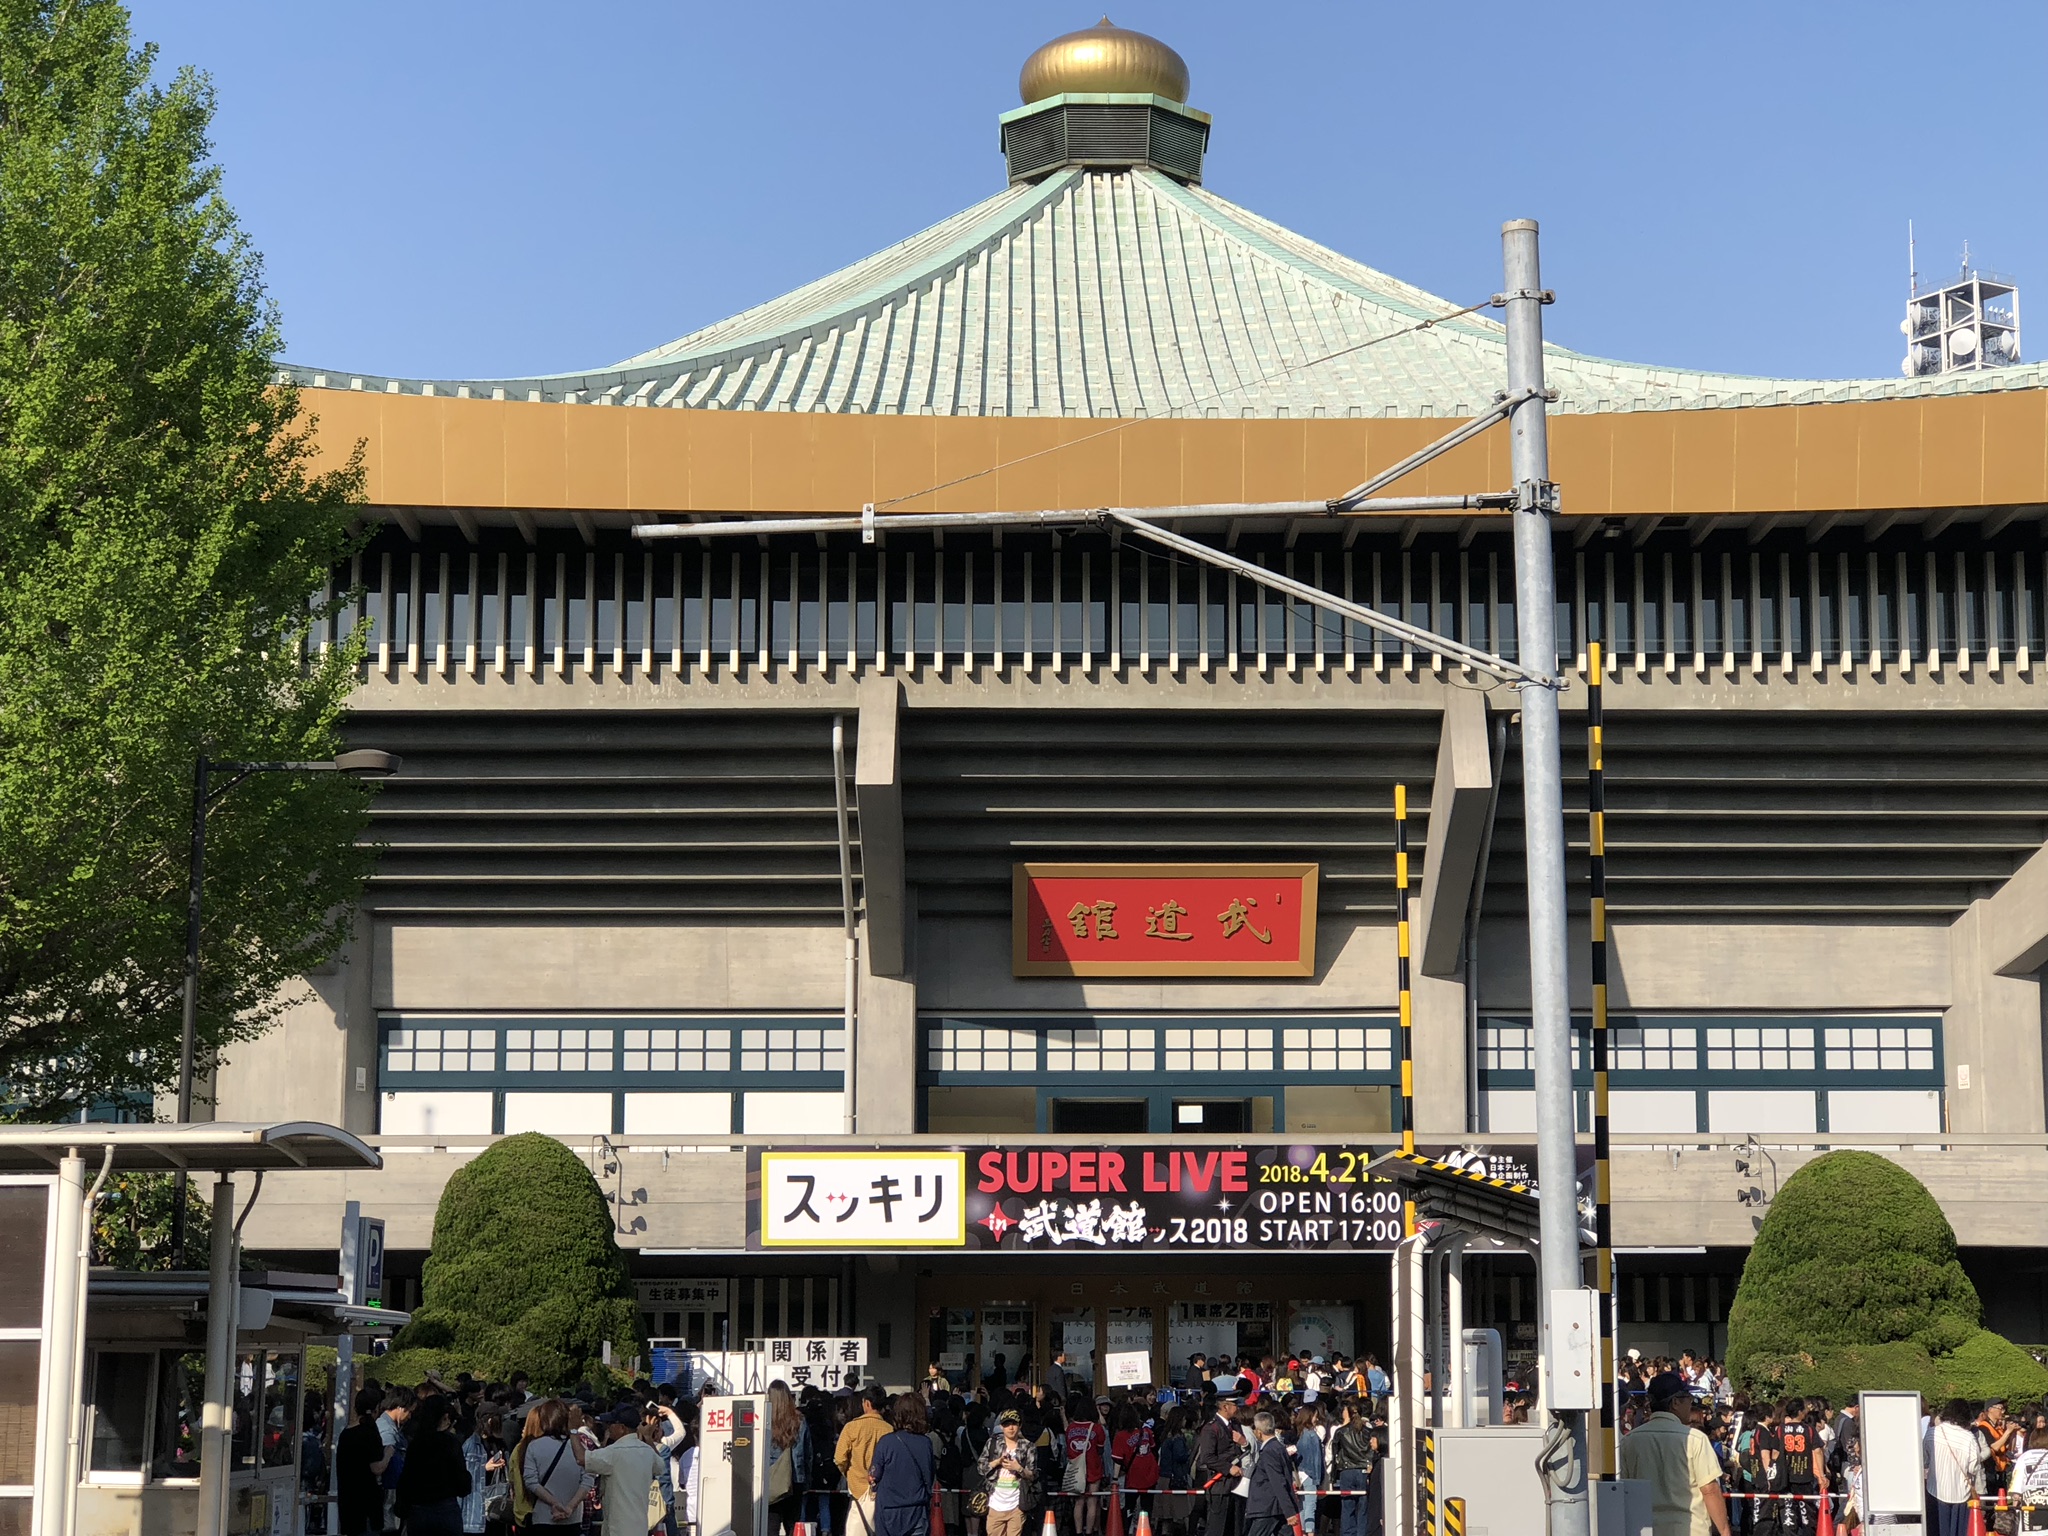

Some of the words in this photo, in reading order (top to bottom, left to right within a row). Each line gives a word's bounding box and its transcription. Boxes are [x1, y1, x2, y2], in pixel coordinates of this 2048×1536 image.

[977, 1151, 1127, 1193] SUPER
[1143, 1151, 1248, 1193] LIVE
[1260, 1152, 1370, 1183] 2018.4.21
[1490, 1163, 1527, 1171] 日本テレビ
[1498, 1171, 1529, 1180] 企画制作
[784, 1174, 943, 1223] スッキリ
[1260, 1191, 1331, 1213] OPEN
[1338, 1191, 1401, 1213] 16:00
[989, 1212, 1007, 1231] in
[1260, 1219, 1334, 1241] START
[1338, 1219, 1401, 1241] 17:00
[649, 1288, 719, 1301] 生徒募集中
[1071, 1280, 1253, 1296] 日本武道館
[771, 1340, 861, 1363] 関係者
[791, 1366, 842, 1388] 受付
[1783, 1434, 1806, 1453] 93
